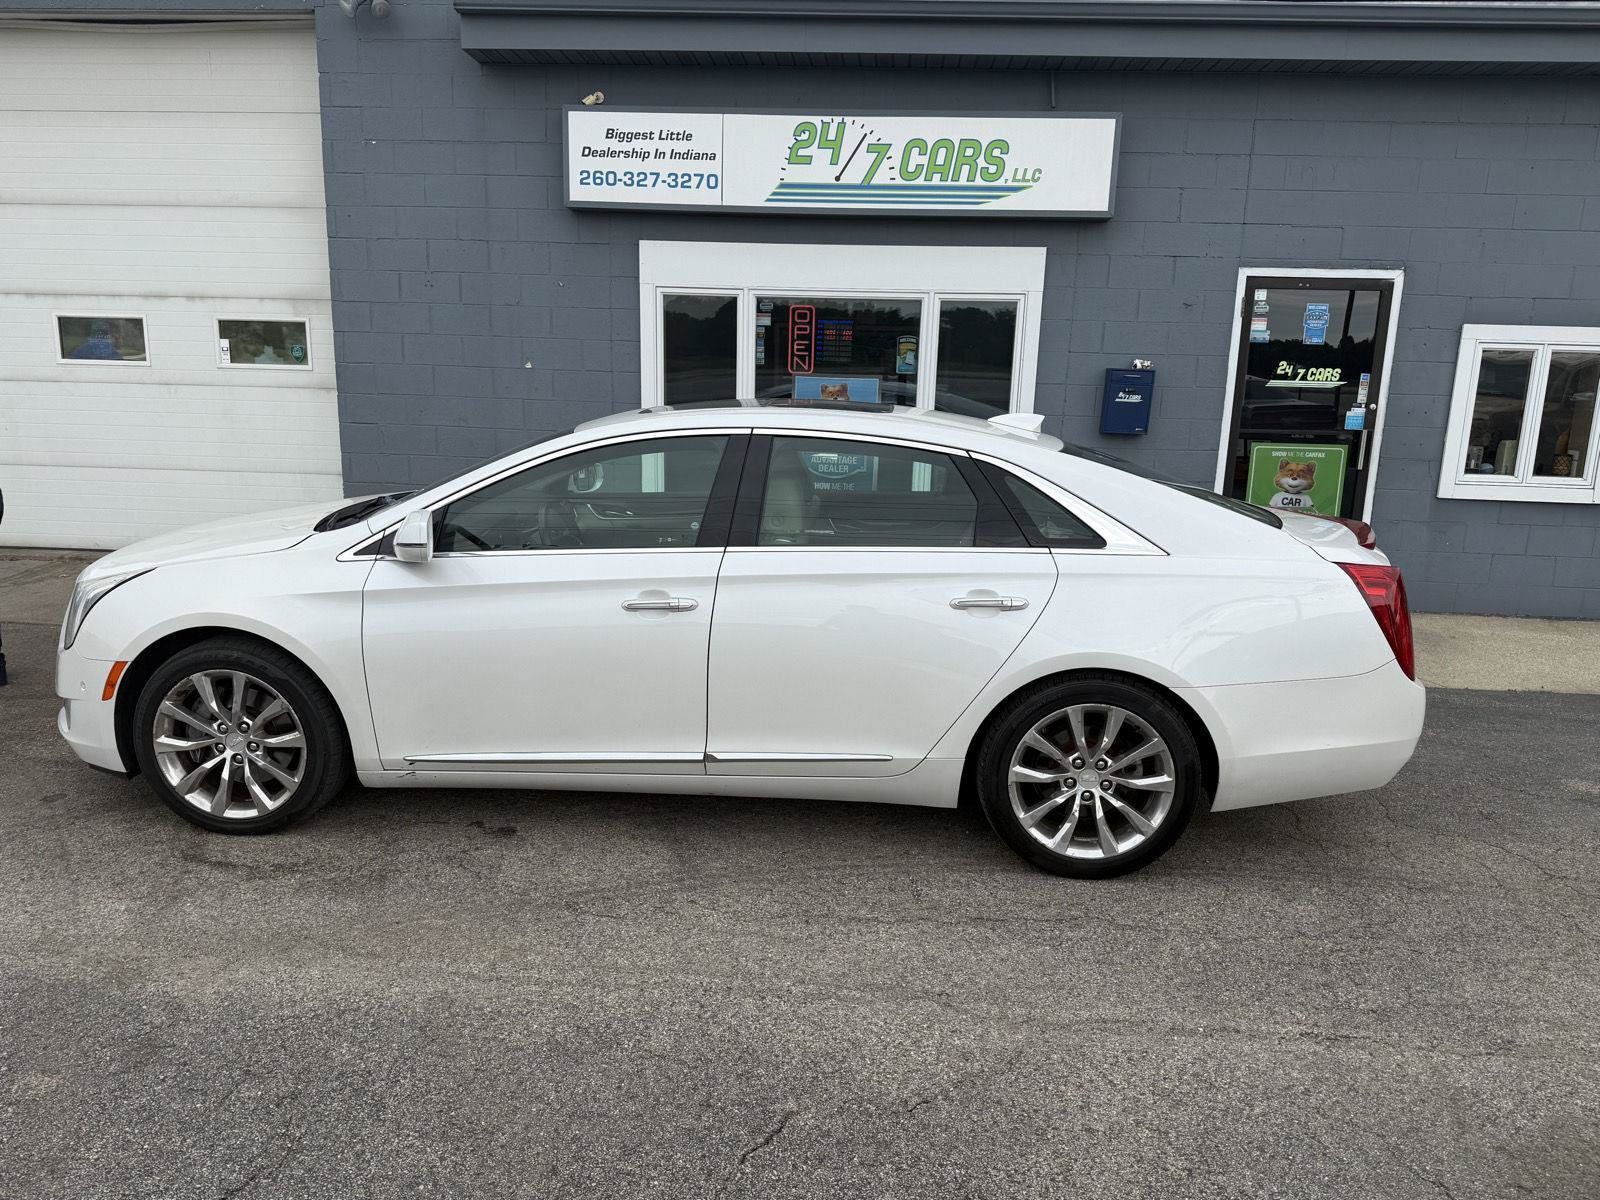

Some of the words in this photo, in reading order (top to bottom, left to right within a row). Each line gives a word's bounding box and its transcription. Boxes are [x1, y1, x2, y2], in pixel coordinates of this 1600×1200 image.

[605, 128, 655, 143] Biggest
[658, 129, 693, 142] Little
[581, 146, 651, 162] Dealership
[654, 148, 667, 160] In
[669, 149, 717, 161] Indiana
[579, 169, 719, 190] 260-327-3270
[793, 309, 810, 371] OPEN
[1306, 367, 1342, 381] CARS
[818, 464, 849, 473] DEALER
[814, 482, 831, 490] HOW
[1281, 497, 1302, 507] CAR
